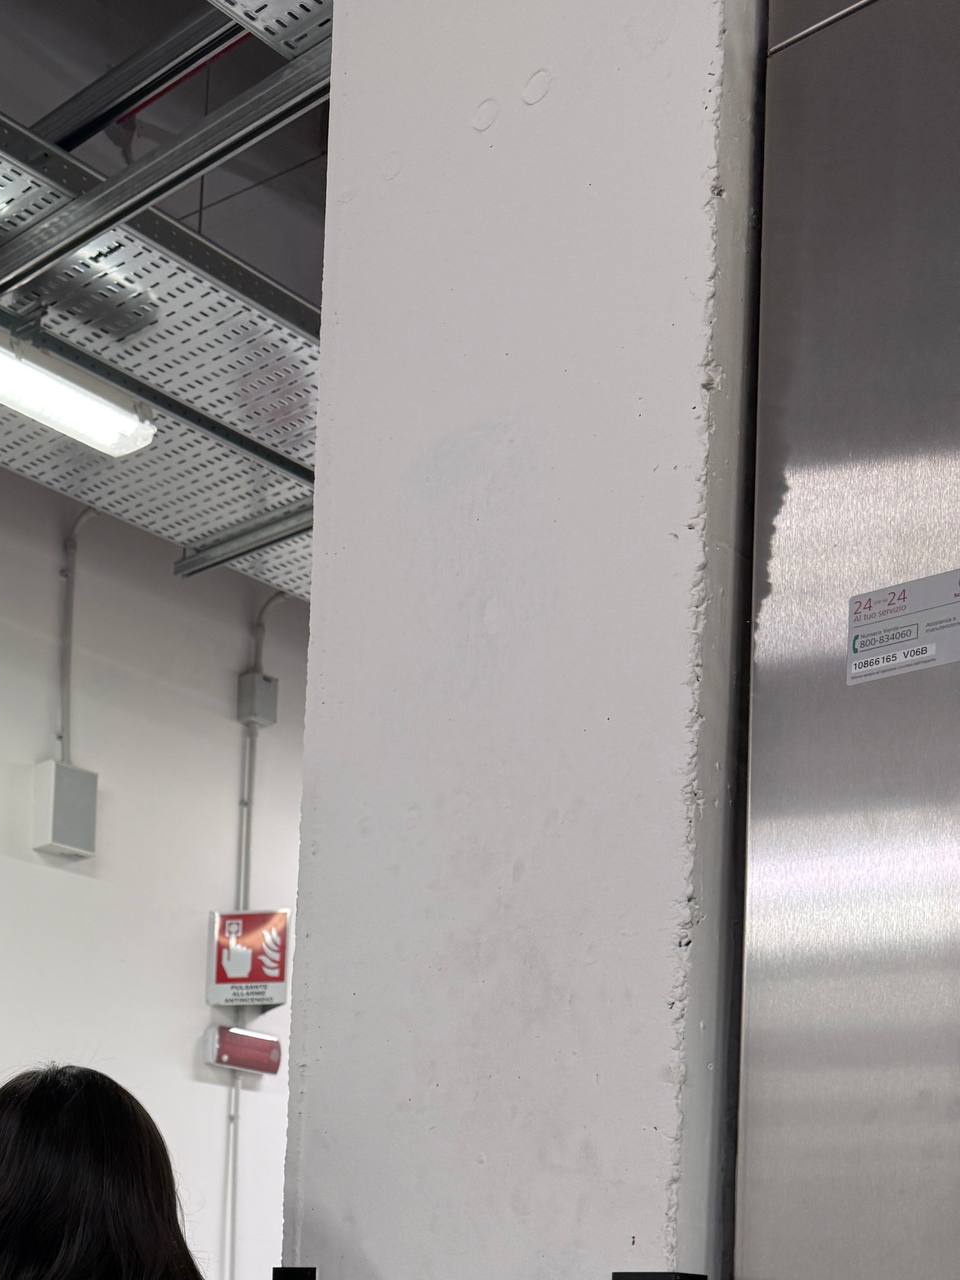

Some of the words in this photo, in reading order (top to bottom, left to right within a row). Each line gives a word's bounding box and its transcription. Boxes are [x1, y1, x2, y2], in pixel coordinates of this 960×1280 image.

[854, 598, 872, 615] 24
[887, 589, 907, 606] 24
[853, 653, 897, 670] 10866165
